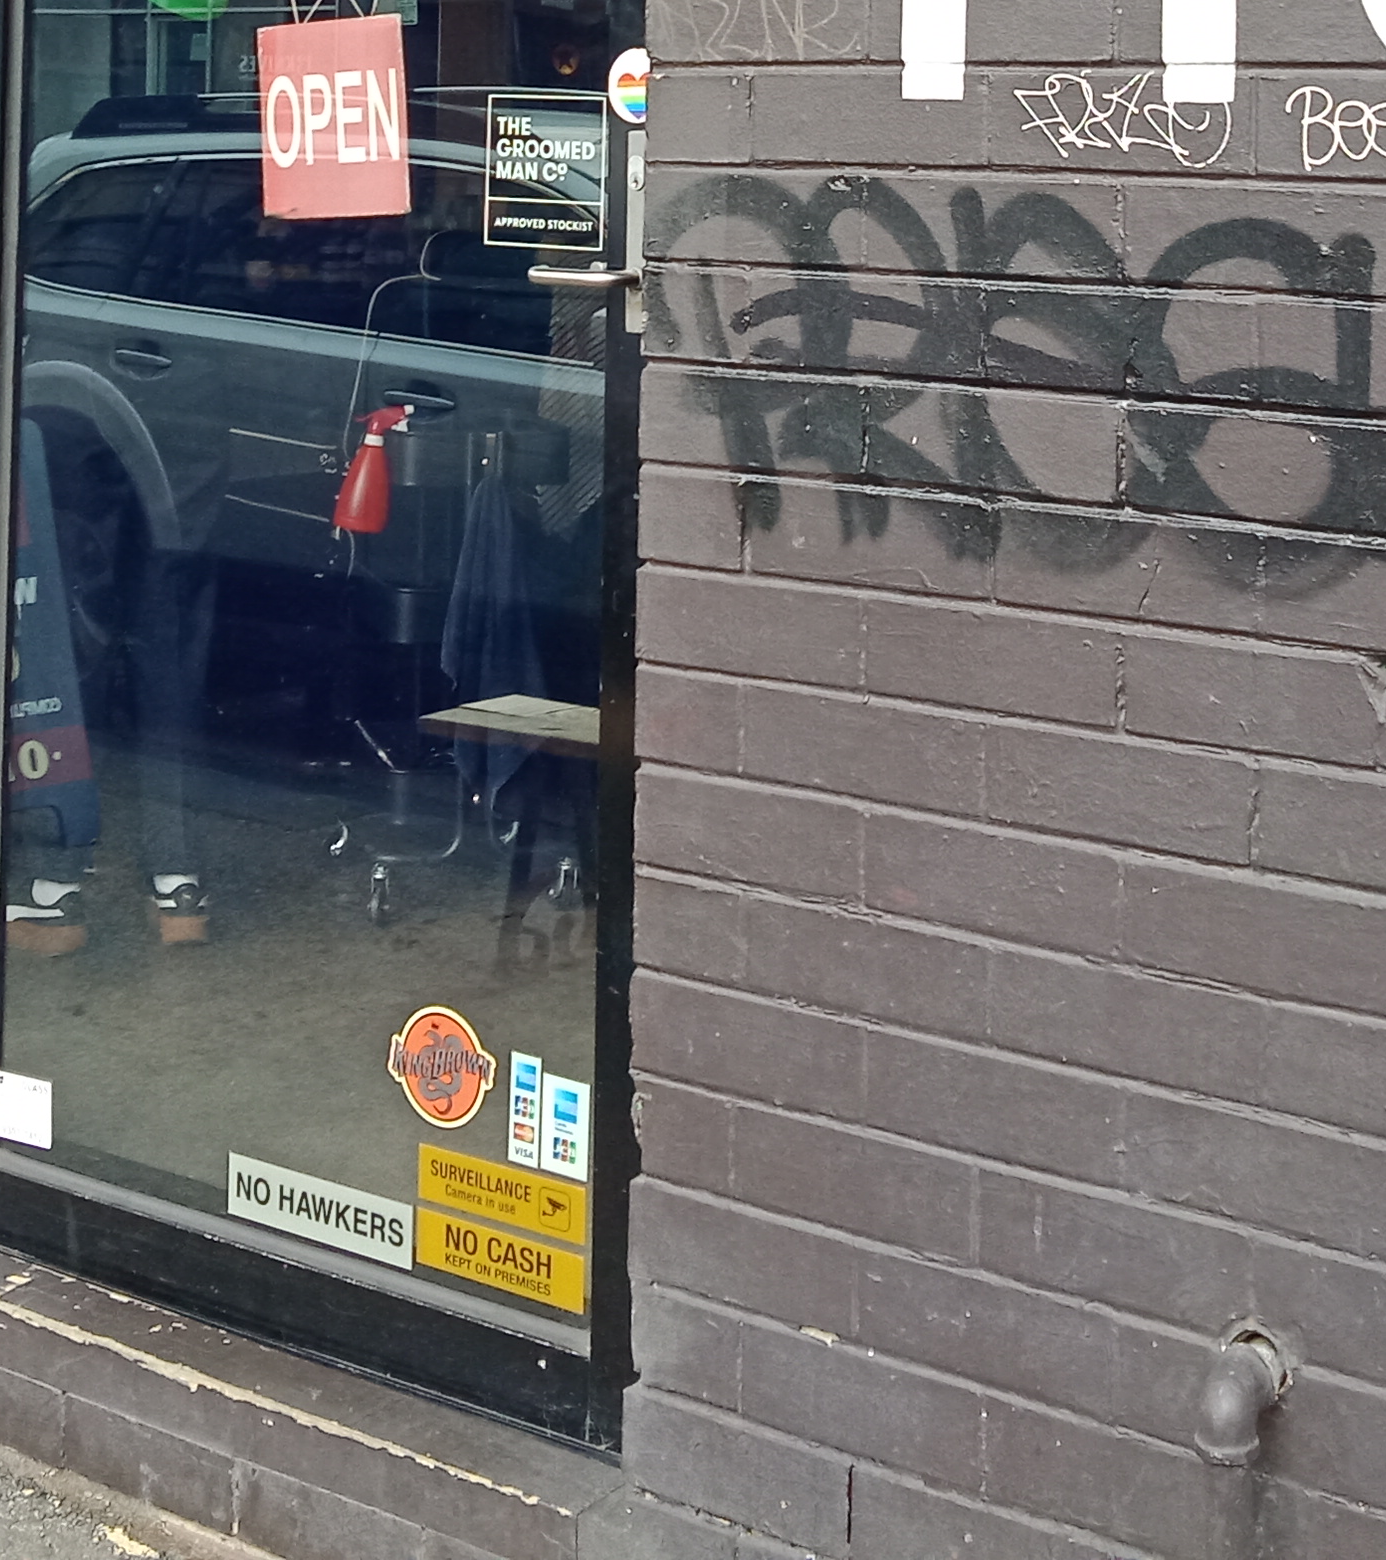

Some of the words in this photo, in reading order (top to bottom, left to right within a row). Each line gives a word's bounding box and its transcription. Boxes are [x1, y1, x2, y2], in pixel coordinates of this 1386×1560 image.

[266, 68, 401, 169] OPEN
[497, 116, 532, 136] THE
[496, 138, 595, 160] GROOMED
[495, 161, 539, 180] MAN
[494, 217, 546, 230] APPROVED
[548, 219, 593, 231] STOCKIST
[514, 1146, 534, 1159] VISA
[430, 1159, 532, 1203] SURVEILLANCE
[236, 1171, 271, 1206] NO
[278, 1184, 404, 1247] HAWKERS
[445, 1183, 483, 1205] Camera
[498, 1203, 516, 1215] use
[445, 1224, 478, 1256] NO
[487, 1237, 552, 1279] CASH
[445, 1253, 472, 1270] KEPT
[475, 1262, 491, 1277] ON
[494, 1269, 551, 1296] PREMISES
